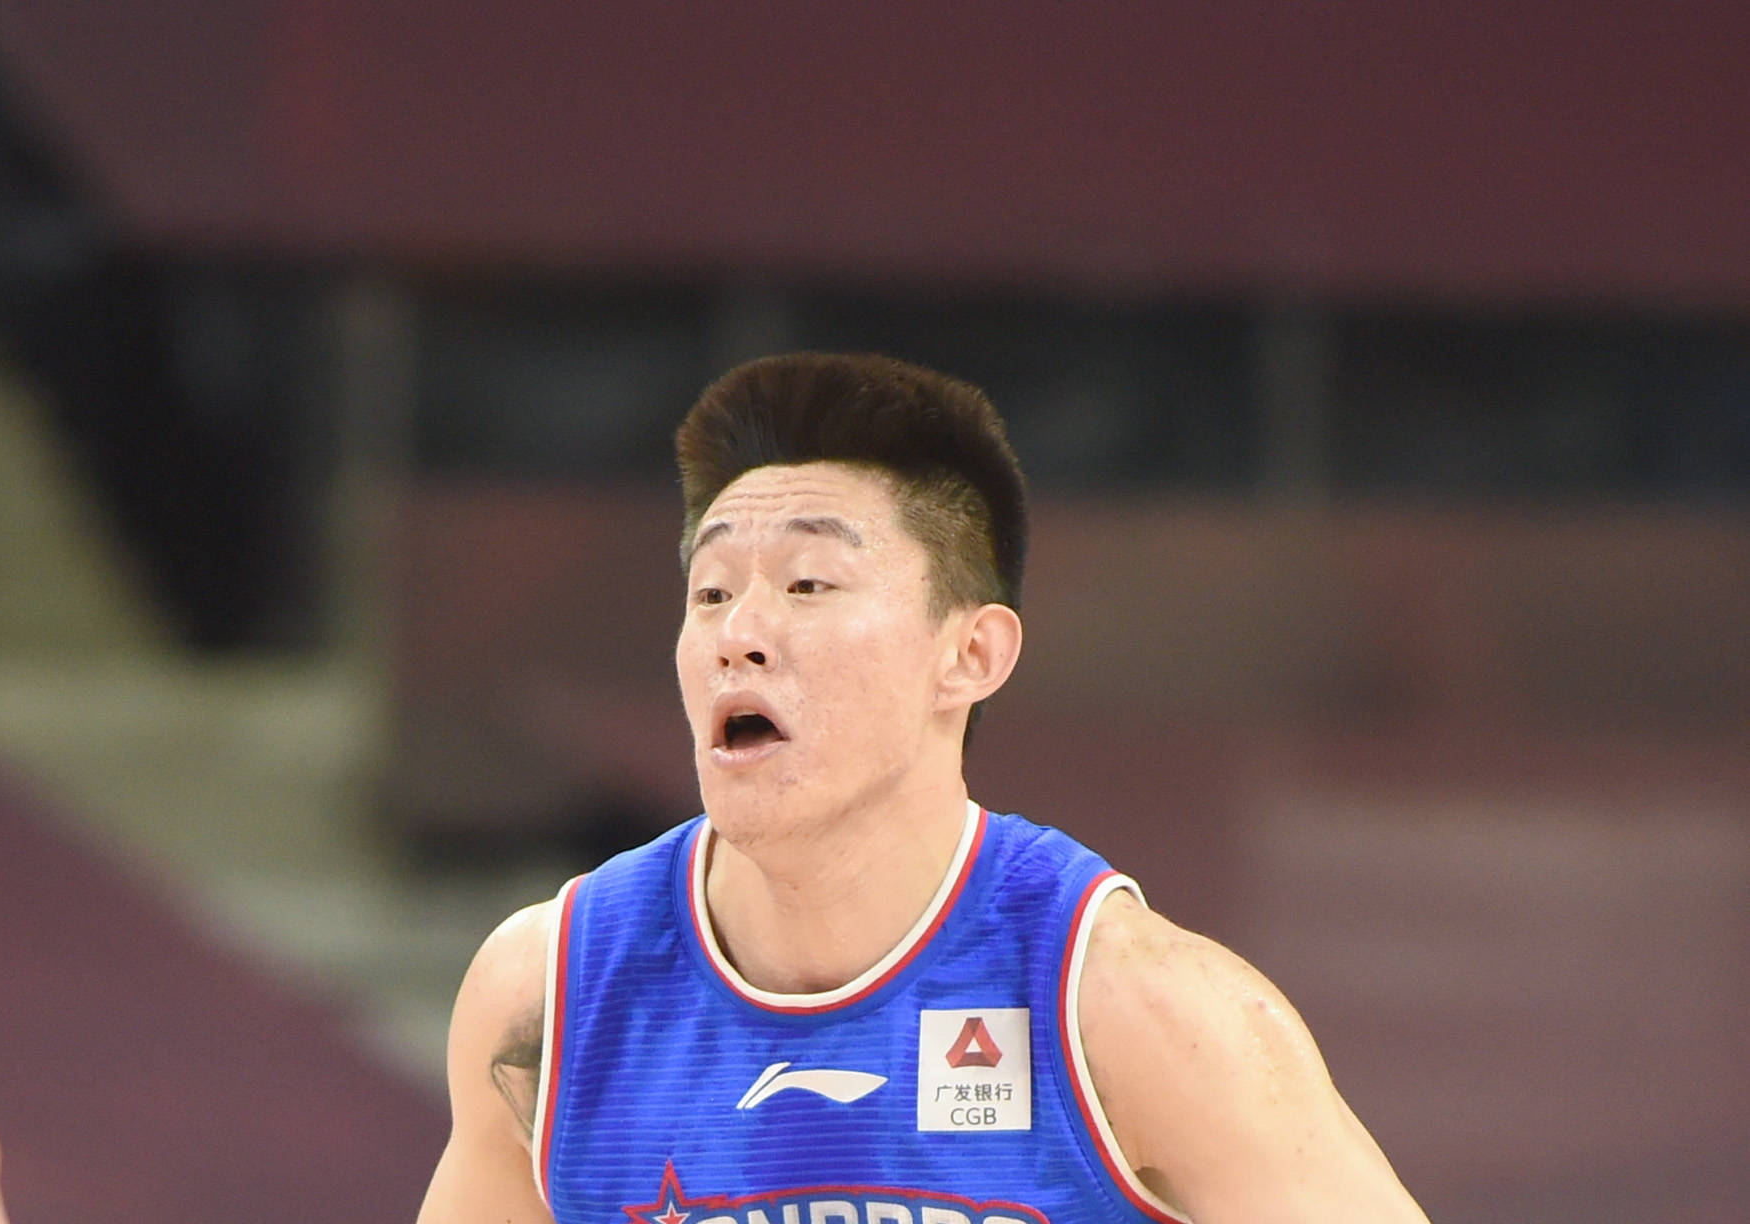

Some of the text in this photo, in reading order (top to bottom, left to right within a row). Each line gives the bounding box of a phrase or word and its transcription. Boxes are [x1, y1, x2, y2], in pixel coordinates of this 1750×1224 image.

[934, 1082, 1013, 1102] 广发银行
[950, 1106, 997, 1126] CGB
